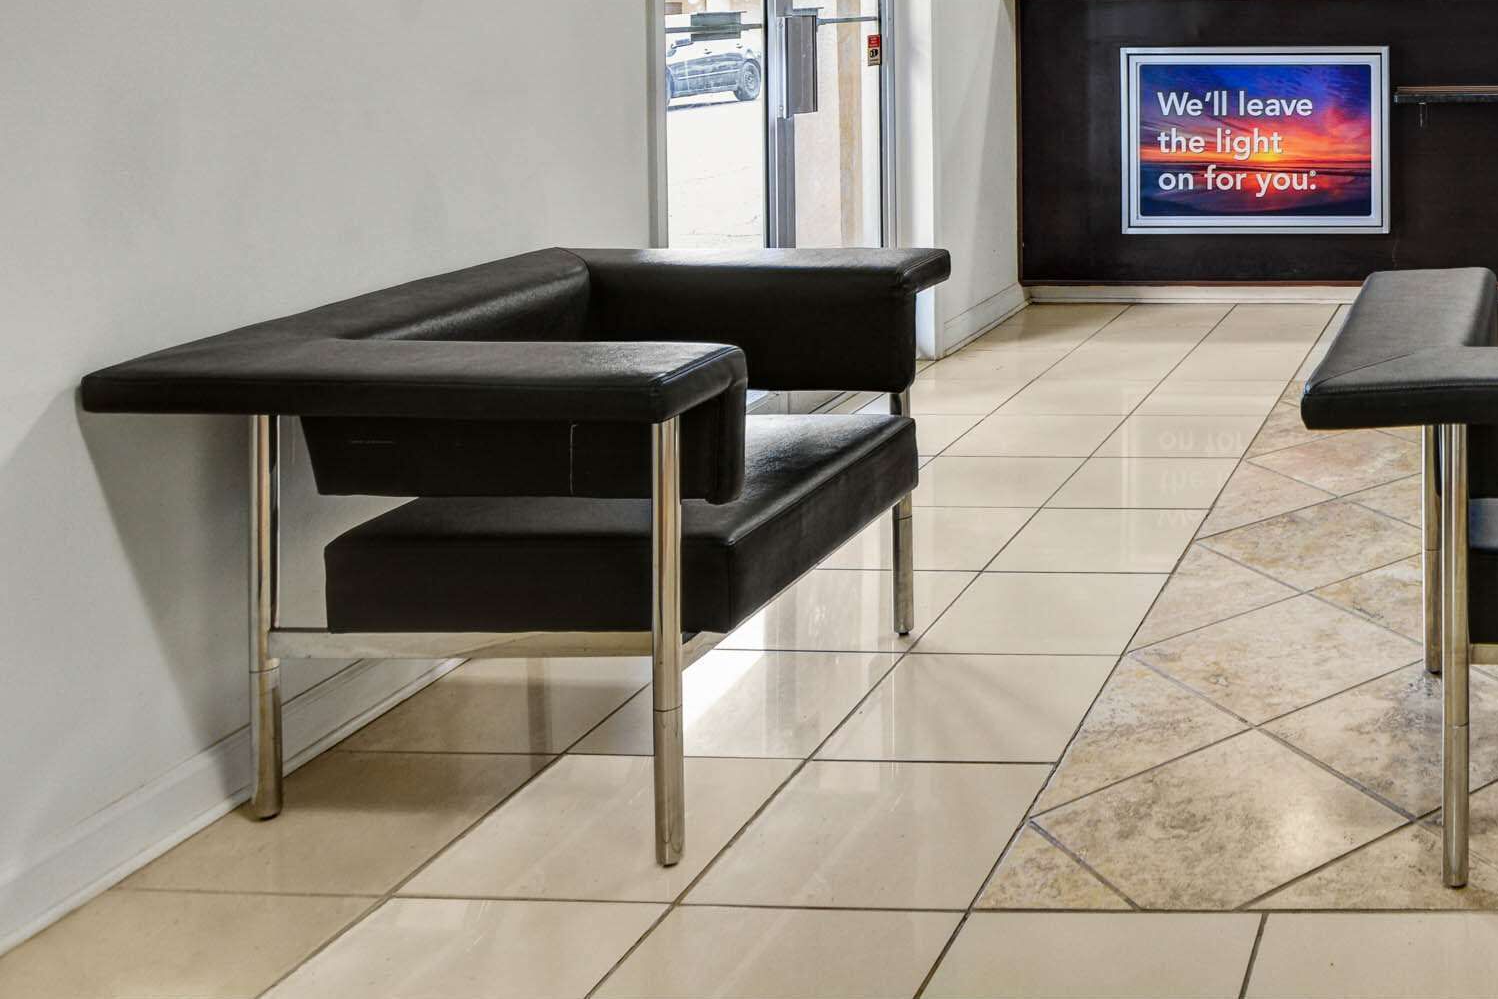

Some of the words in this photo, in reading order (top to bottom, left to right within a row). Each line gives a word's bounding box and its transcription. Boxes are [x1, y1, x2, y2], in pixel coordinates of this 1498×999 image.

[1157, 90, 1227, 117] We'll
[1239, 90, 1313, 117] leave
[1157, 127, 1205, 154] the
[1216, 127, 1283, 161] light
[1158, 172, 1194, 191] on
[1204, 164, 1247, 191] for
